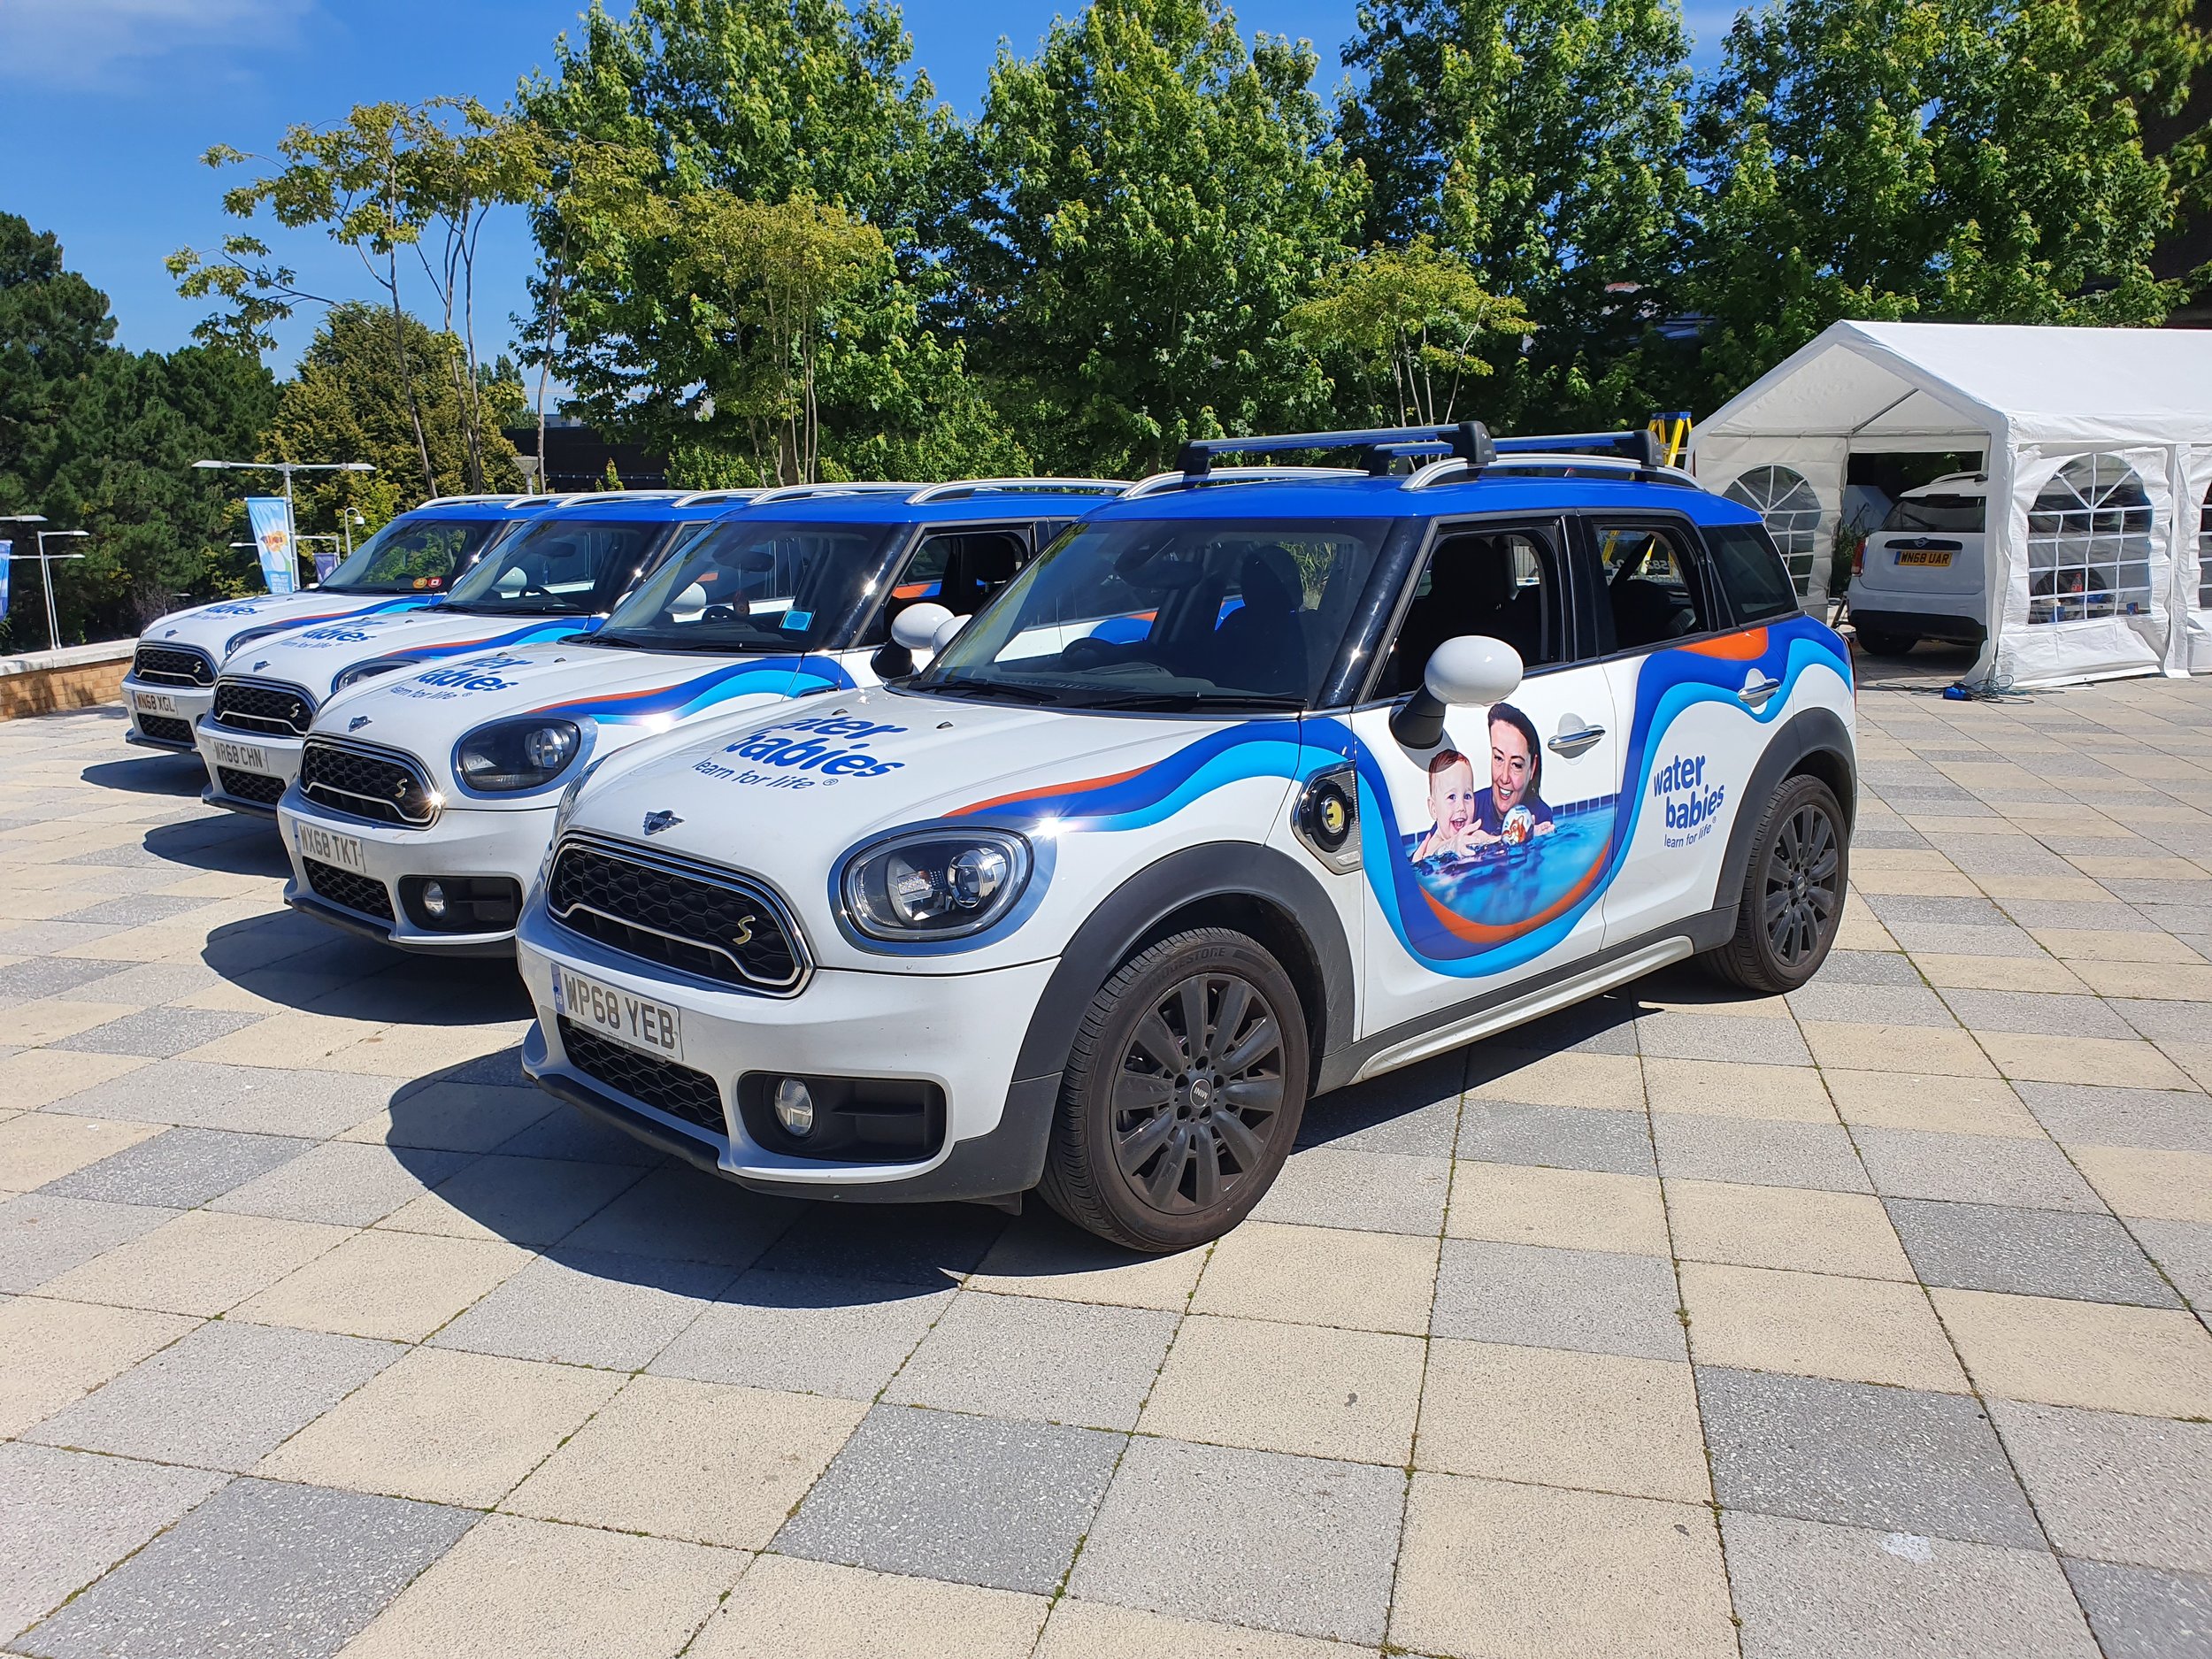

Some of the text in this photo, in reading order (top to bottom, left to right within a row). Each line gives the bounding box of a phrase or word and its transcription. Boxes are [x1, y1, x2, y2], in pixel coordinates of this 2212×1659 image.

[1901, 552, 1950, 565] WN68 UAR
[136, 693, 175, 712] WN68 XGL
[213, 741, 263, 768] WR68 CHN
[692, 757, 816, 789] learn for life
[1654, 754, 1706, 797] water
[1665, 784, 1724, 829] babies
[299, 825, 358, 866] WX68 TKT
[1663, 824, 1712, 849] learn for life
[564, 973, 621, 1030] WP68
[625, 997, 675, 1050] YEB
